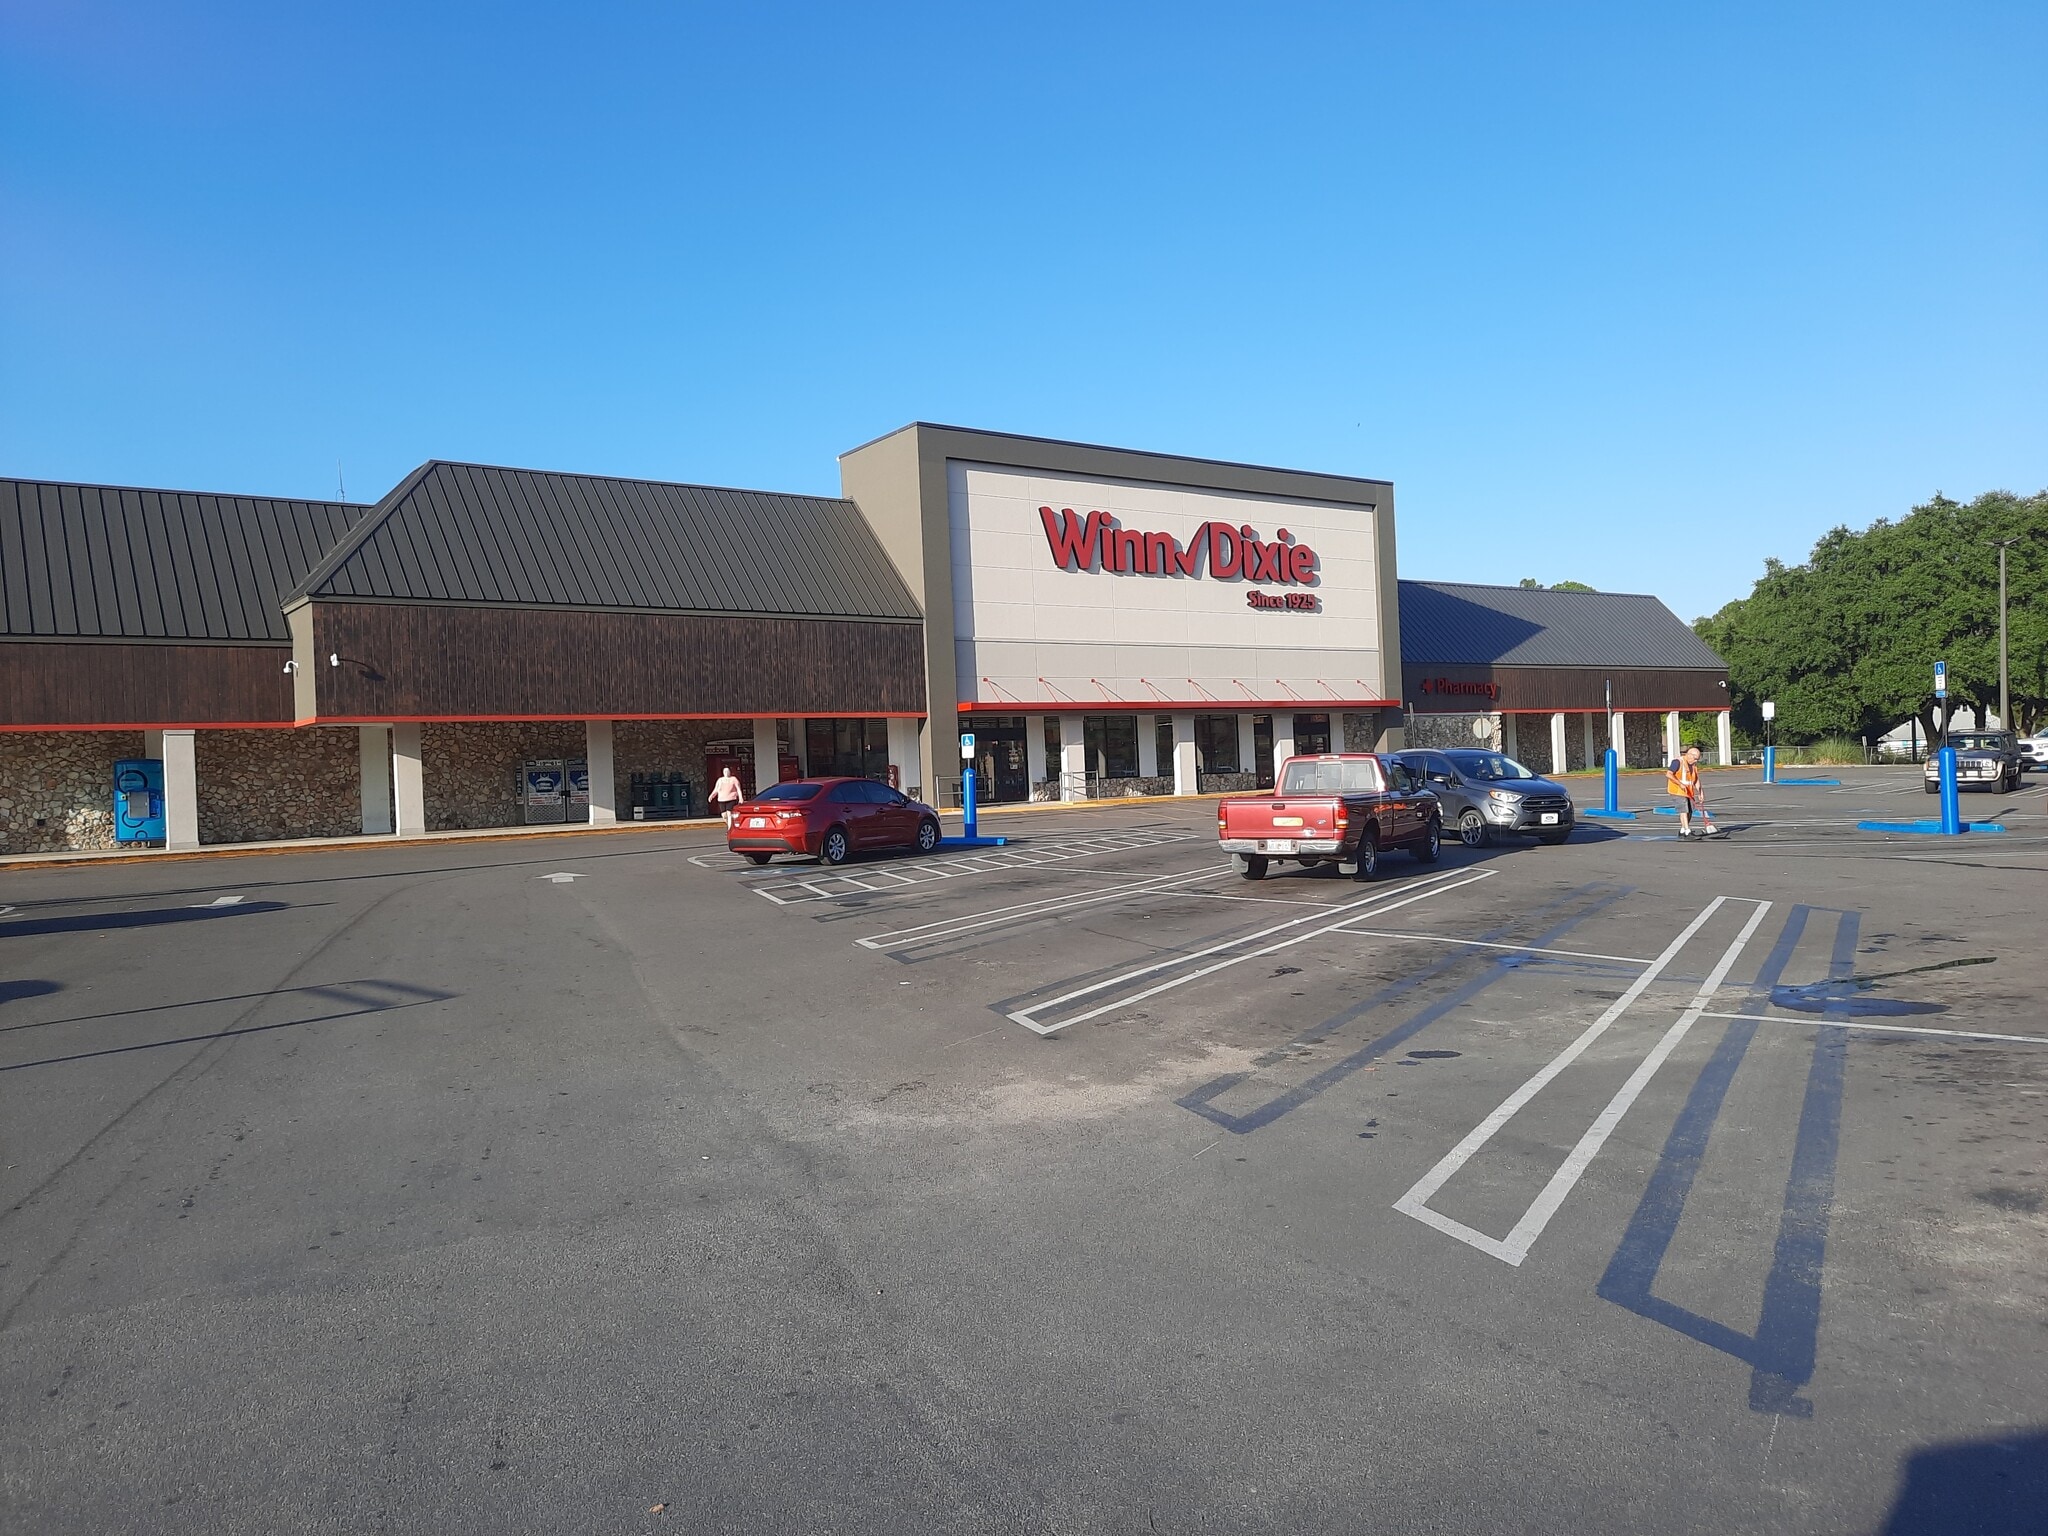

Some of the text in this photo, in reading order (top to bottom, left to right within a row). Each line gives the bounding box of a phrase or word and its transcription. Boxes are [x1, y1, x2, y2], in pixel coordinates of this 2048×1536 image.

[1208, 521, 1315, 583] Dixie
[1247, 590, 1316, 609] Since 1925
[1436, 677, 1497, 699] Pharmacy
